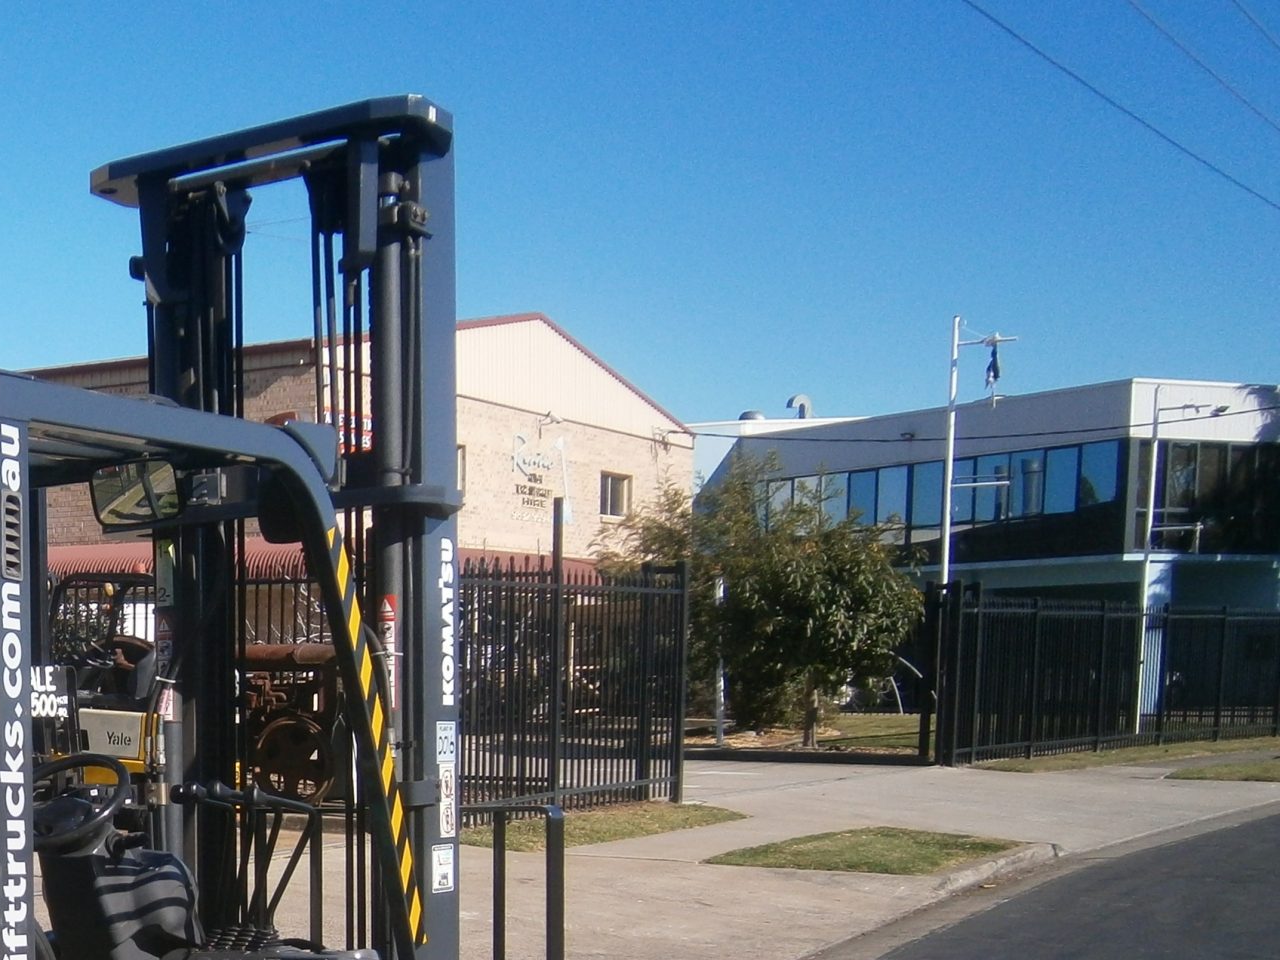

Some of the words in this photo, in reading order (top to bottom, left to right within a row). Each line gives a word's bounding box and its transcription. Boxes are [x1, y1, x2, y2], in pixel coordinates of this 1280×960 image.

[439, 537, 456, 706] KOMATSU
[31, 665, 57, 692] ALE
[106, 730, 132, 746] Yale
